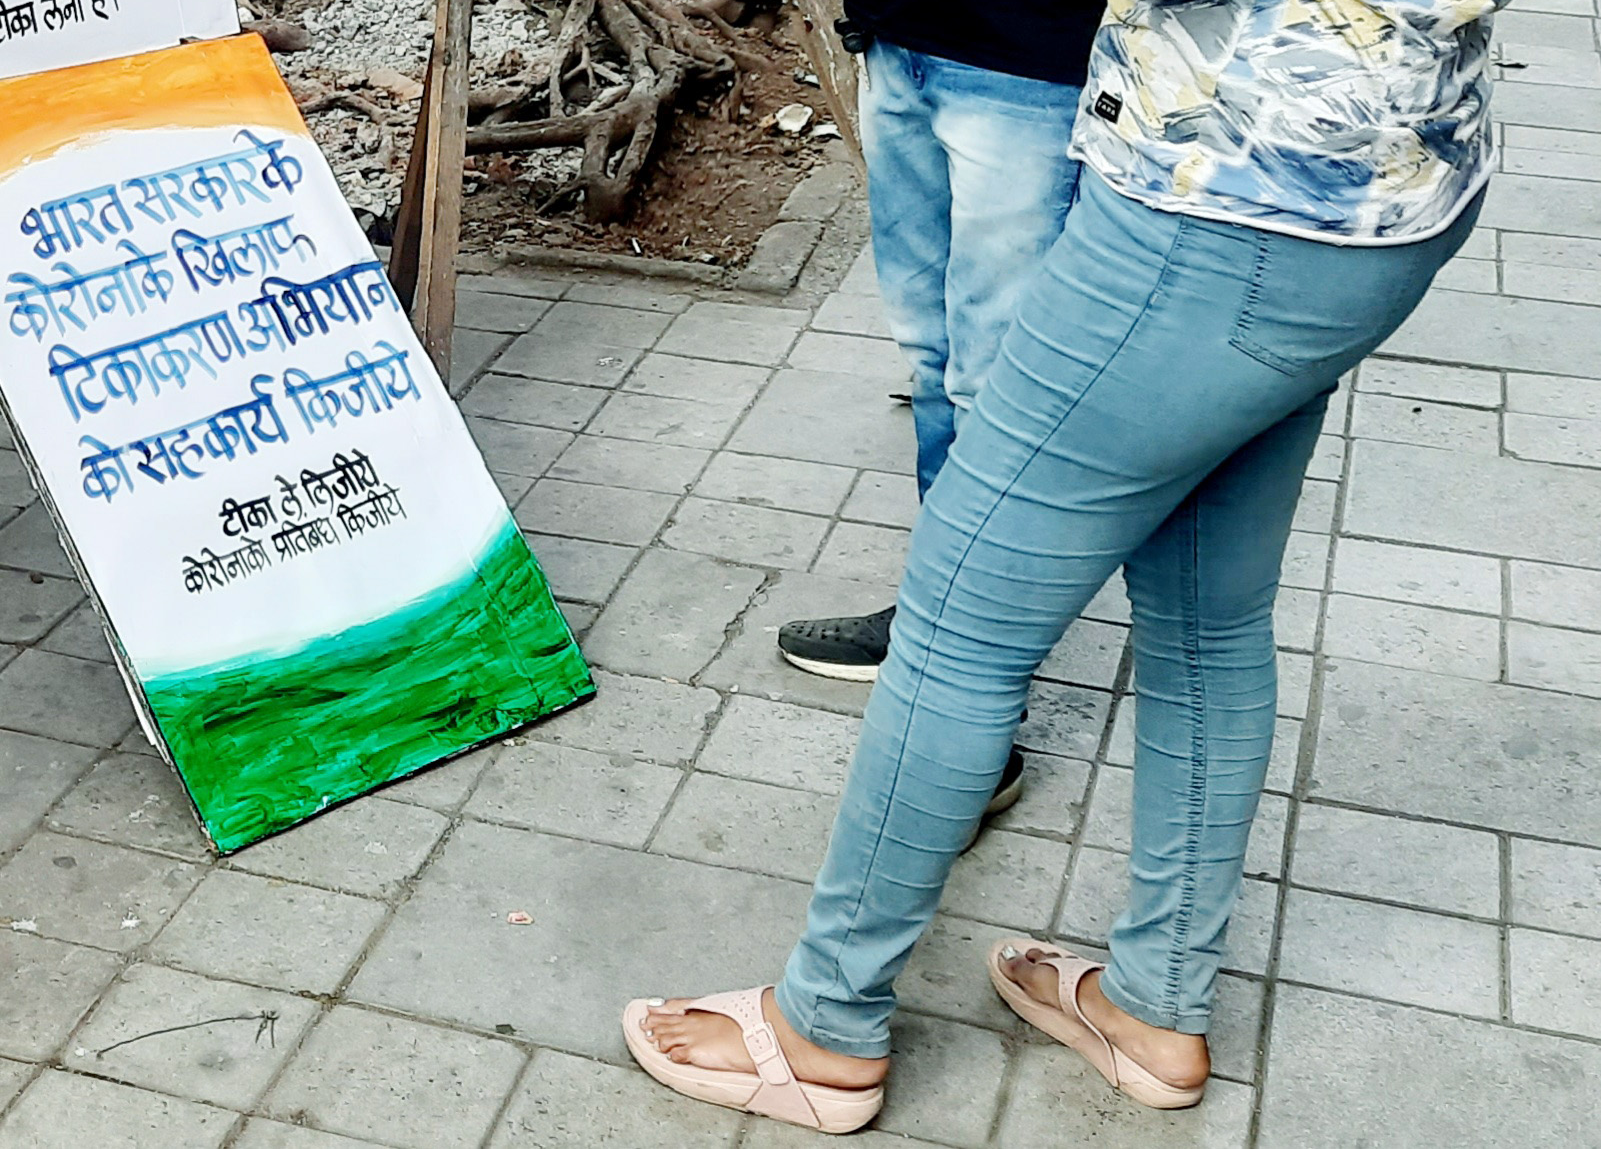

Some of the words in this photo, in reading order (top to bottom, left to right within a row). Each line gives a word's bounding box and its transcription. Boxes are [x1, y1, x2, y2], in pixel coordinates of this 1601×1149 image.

[20, 184, 134, 259] भारत
[48, 310, 247, 424] टिकाकरण
[239, 260, 400, 351] अभियान
[283, 340, 422, 434] किजीये
[219, 498, 278, 537] टीका
[300, 448, 380, 514] लिजीये
[337, 483, 408, 539] किजीये
